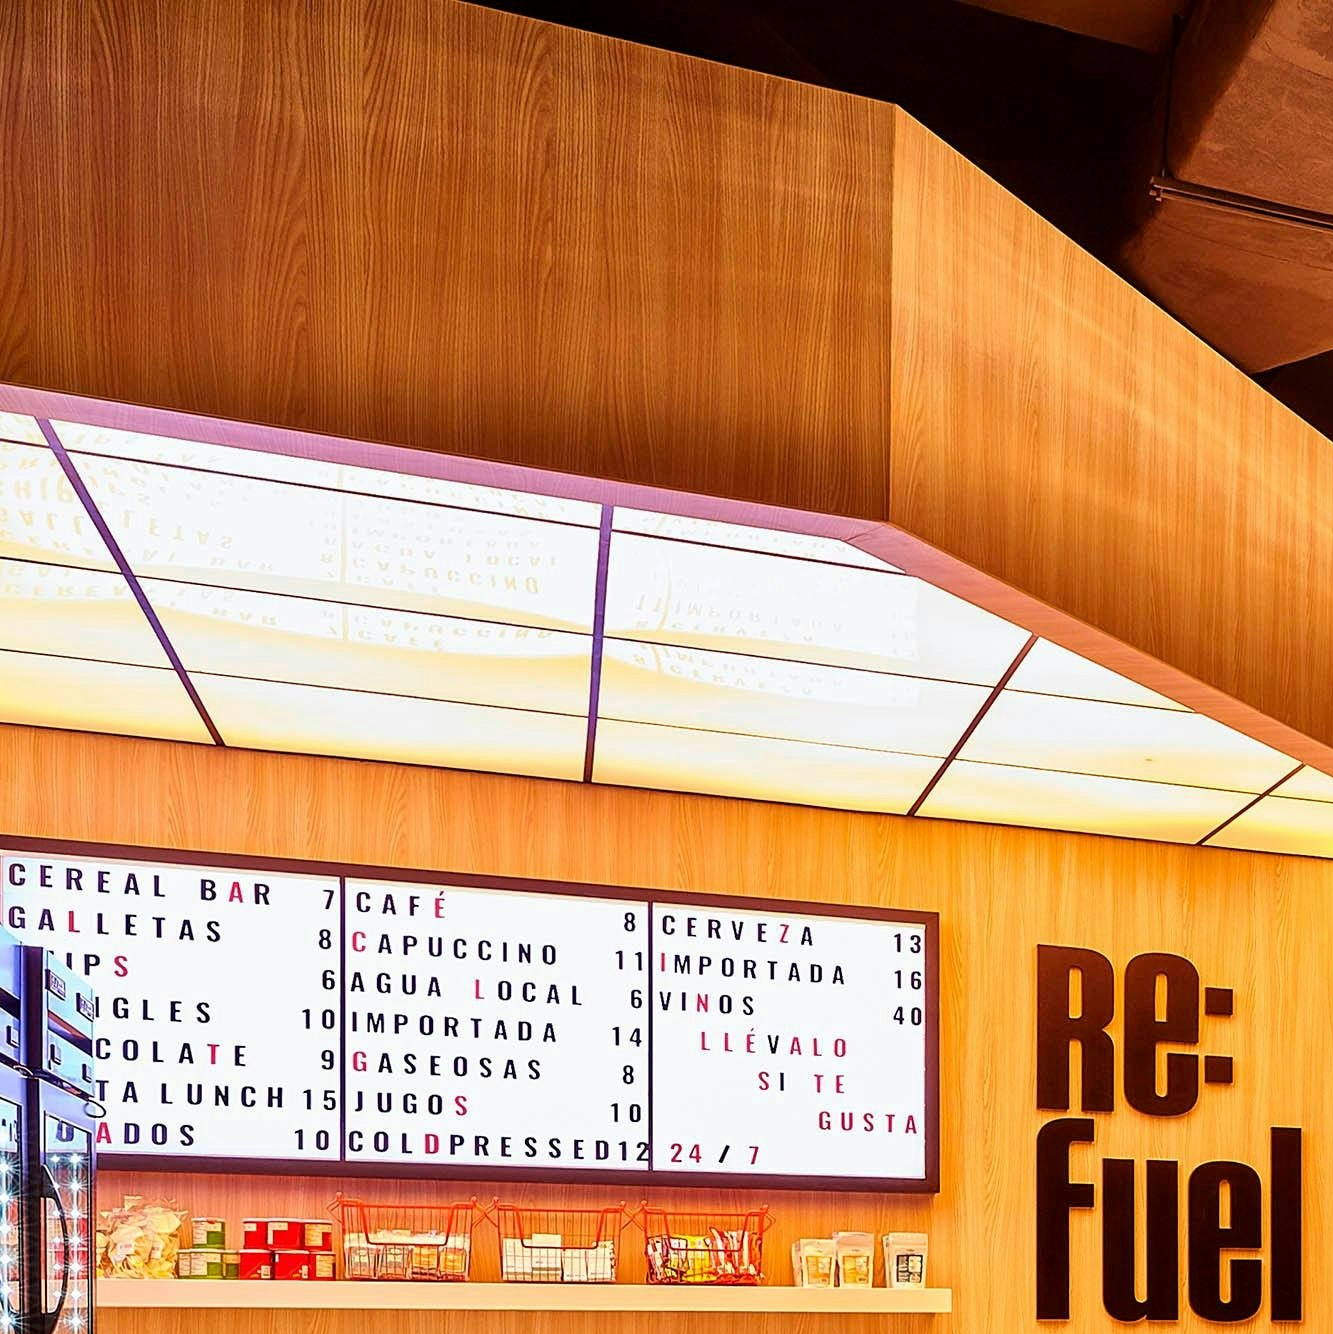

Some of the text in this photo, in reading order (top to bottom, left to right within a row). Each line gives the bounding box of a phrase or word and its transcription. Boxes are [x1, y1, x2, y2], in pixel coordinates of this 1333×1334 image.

[8, 863, 335, 911] CEREAL BAR 7
[8, 905, 332, 950] GALLETAS 8
[356, 890, 636, 933] CAFÉ 8
[351, 931, 643, 972] CAPUCCINO 11
[662, 914, 922, 955] CERVEZA 13
[49, 950, 336, 991] IPS 6
[660, 952, 922, 991] IMPORTADA 16
[350, 971, 643, 1010] AGUA LOCAL 6
[301, 1008, 335, 1031] 10
[659, 991, 923, 1027] VINOS 40
[351, 1011, 643, 1048] IMPORTADA 14
[701, 1028, 847, 1058] LLÉVALO
[95, 1037, 335, 1071] COLATE 9
[352, 1051, 635, 1085] GASEOSAS 8
[95, 1079, 337, 1112] TA LUNCH 15
[758, 1071, 845, 1095] SI TE
[354, 1090, 642, 1123] JUGOS 10
[818, 1111, 918, 1135] GUSTA
[294, 1128, 330, 1151] 10
[348, 1130, 649, 1162] COLDPRESSED 12
[1035, 1117, 1303, 1323] fuel
